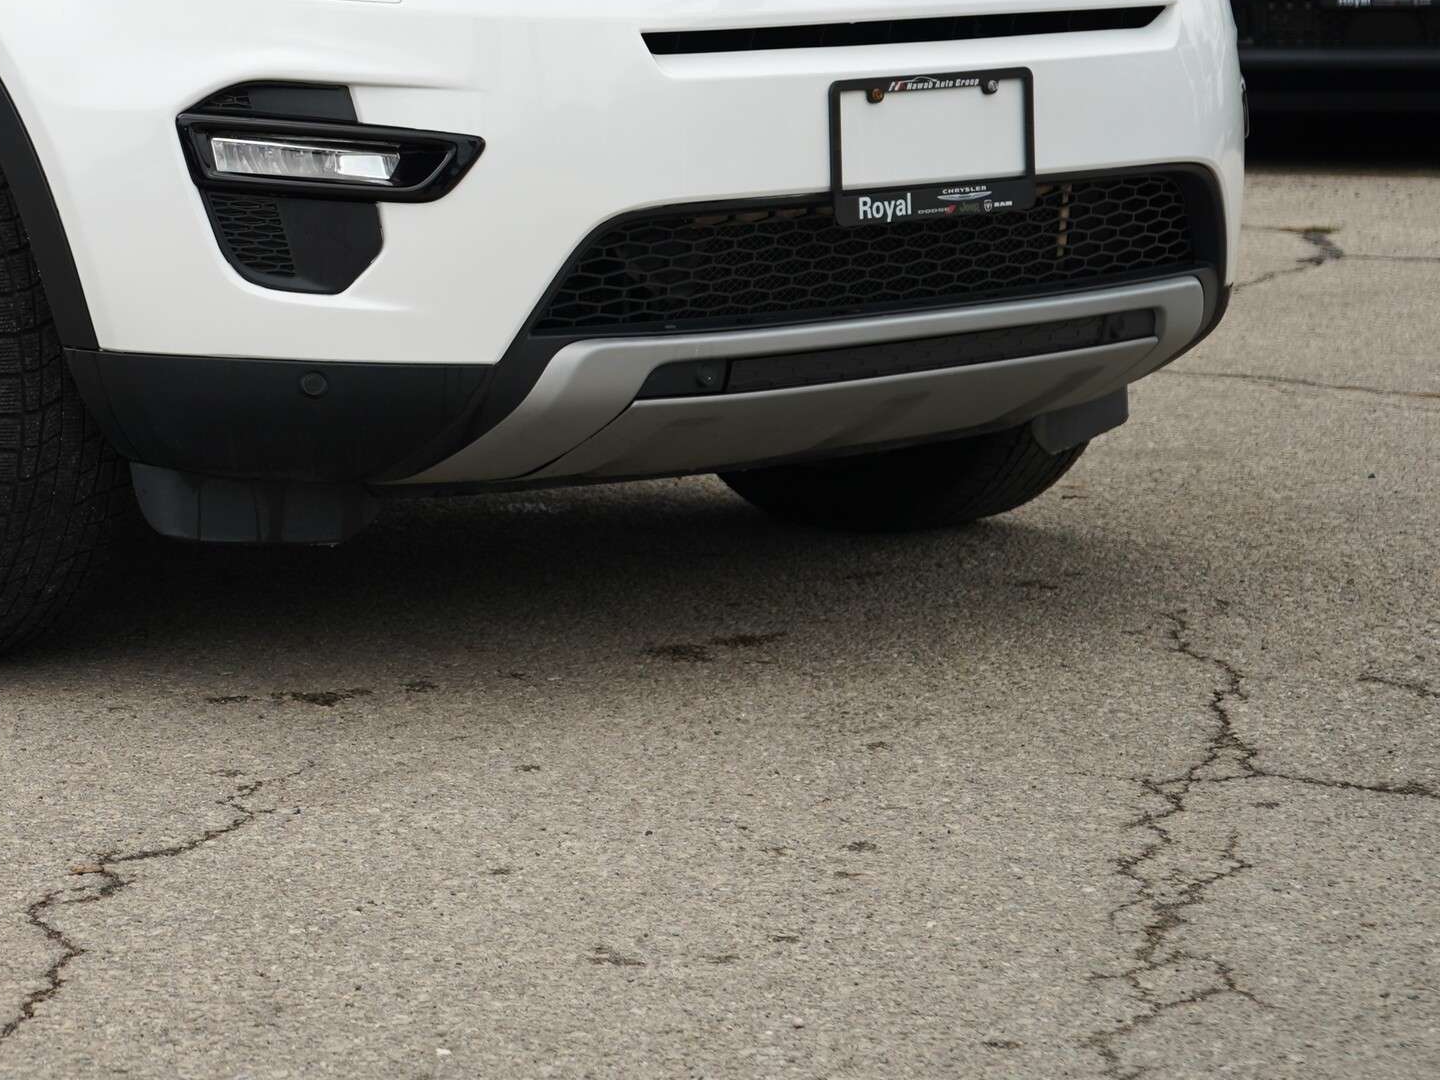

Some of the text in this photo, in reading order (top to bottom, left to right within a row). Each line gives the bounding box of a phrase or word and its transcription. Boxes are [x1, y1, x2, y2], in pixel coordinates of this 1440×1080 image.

[935, 79, 954, 89] Auto
[942, 185, 987, 195] CHRYSLER
[858, 192, 912, 223] Royal
[993, 200, 1013, 208] RAM
